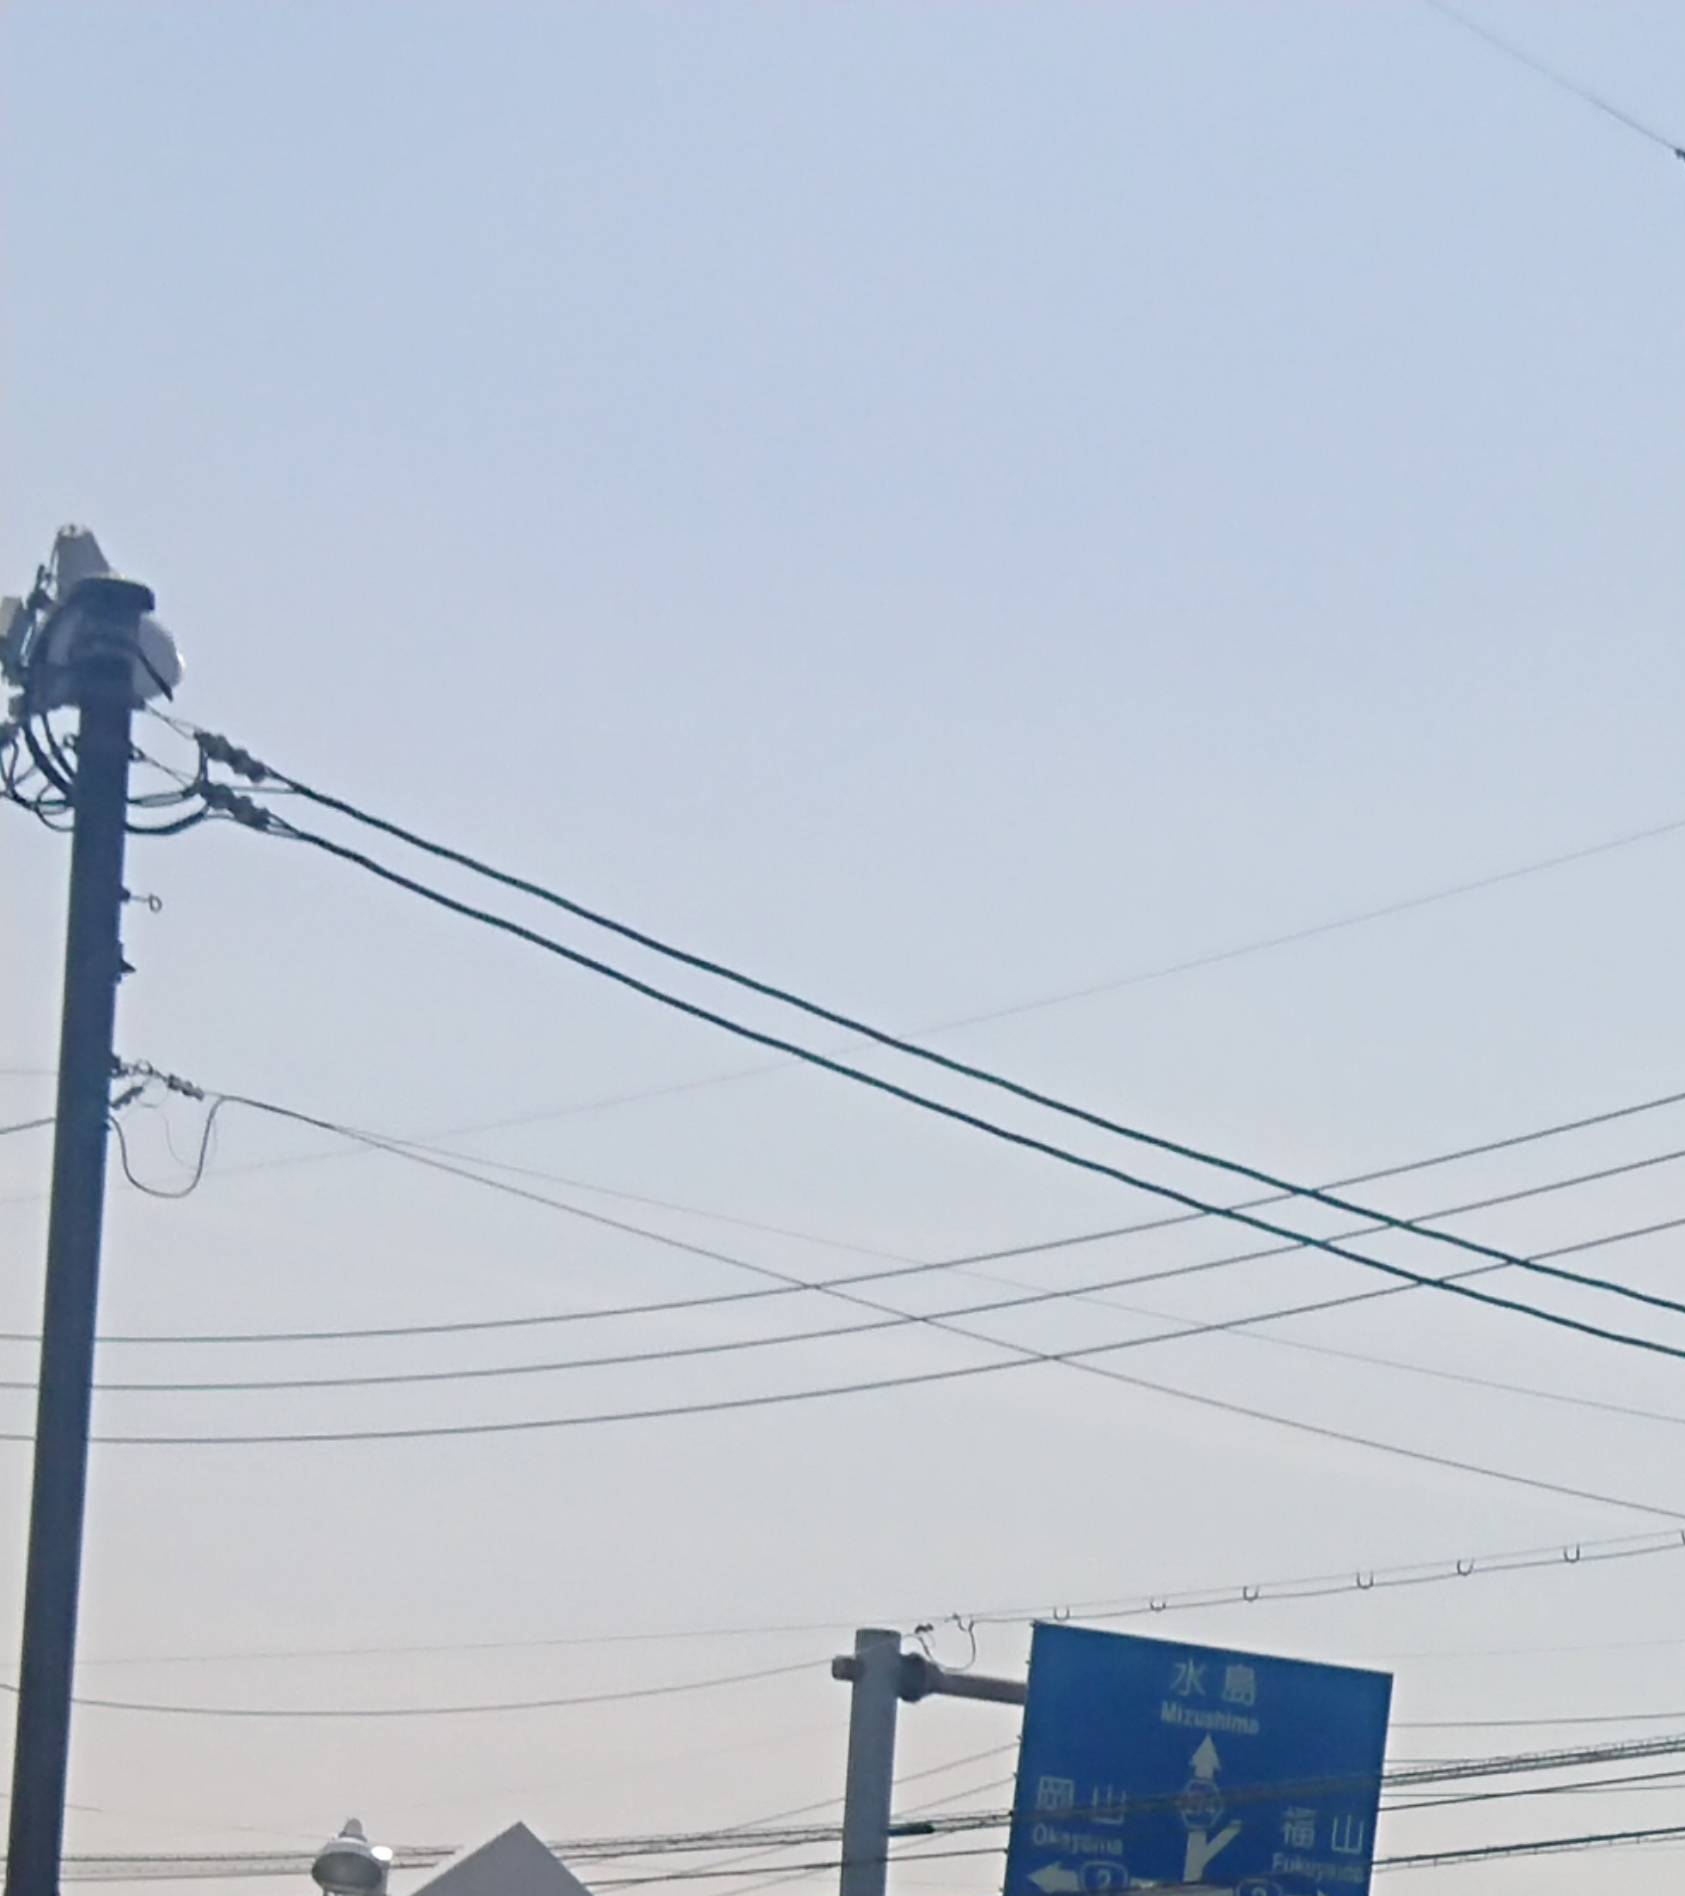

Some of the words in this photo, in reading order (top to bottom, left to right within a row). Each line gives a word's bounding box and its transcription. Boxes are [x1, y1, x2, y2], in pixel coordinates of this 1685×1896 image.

[1168, 1657, 1257, 1707] 水島
[1160, 1699, 1260, 1735] Mizushima
[1035, 1775, 1128, 1825] 岡山
[1280, 1805, 1365, 1855] 福山
[1095, 1868, 1113, 1894] 2
